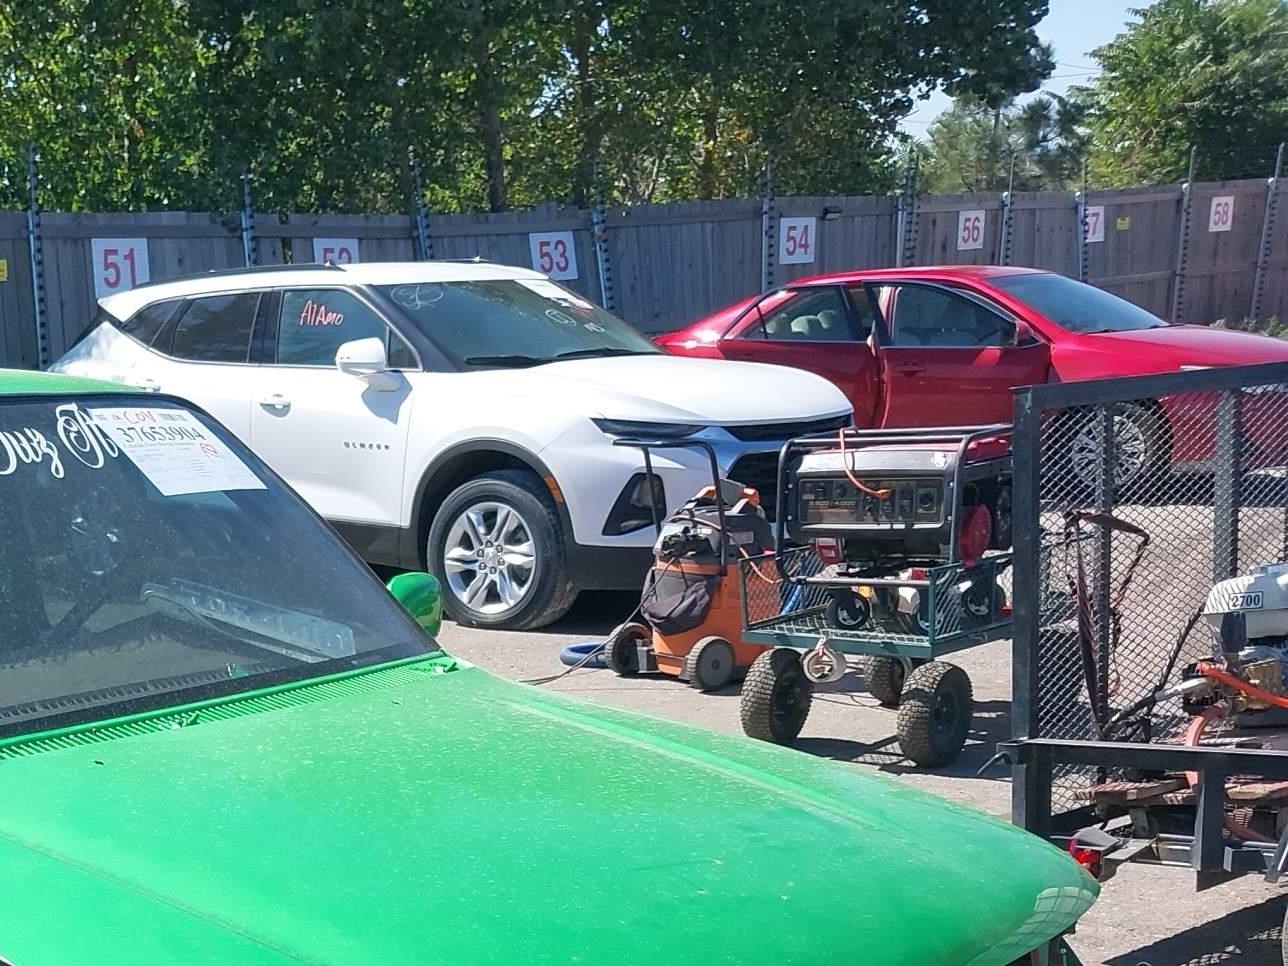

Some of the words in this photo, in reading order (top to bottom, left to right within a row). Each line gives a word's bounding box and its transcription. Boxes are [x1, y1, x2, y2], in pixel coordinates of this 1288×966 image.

[1213, 202, 1229, 227] 58
[785, 225, 809, 257] 54
[962, 216, 980, 244] 56
[103, 247, 137, 289] 51
[539, 239, 569, 273] 53
[116, 426, 207, 443] 37653904
[1231, 594, 1261, 608] 2700
